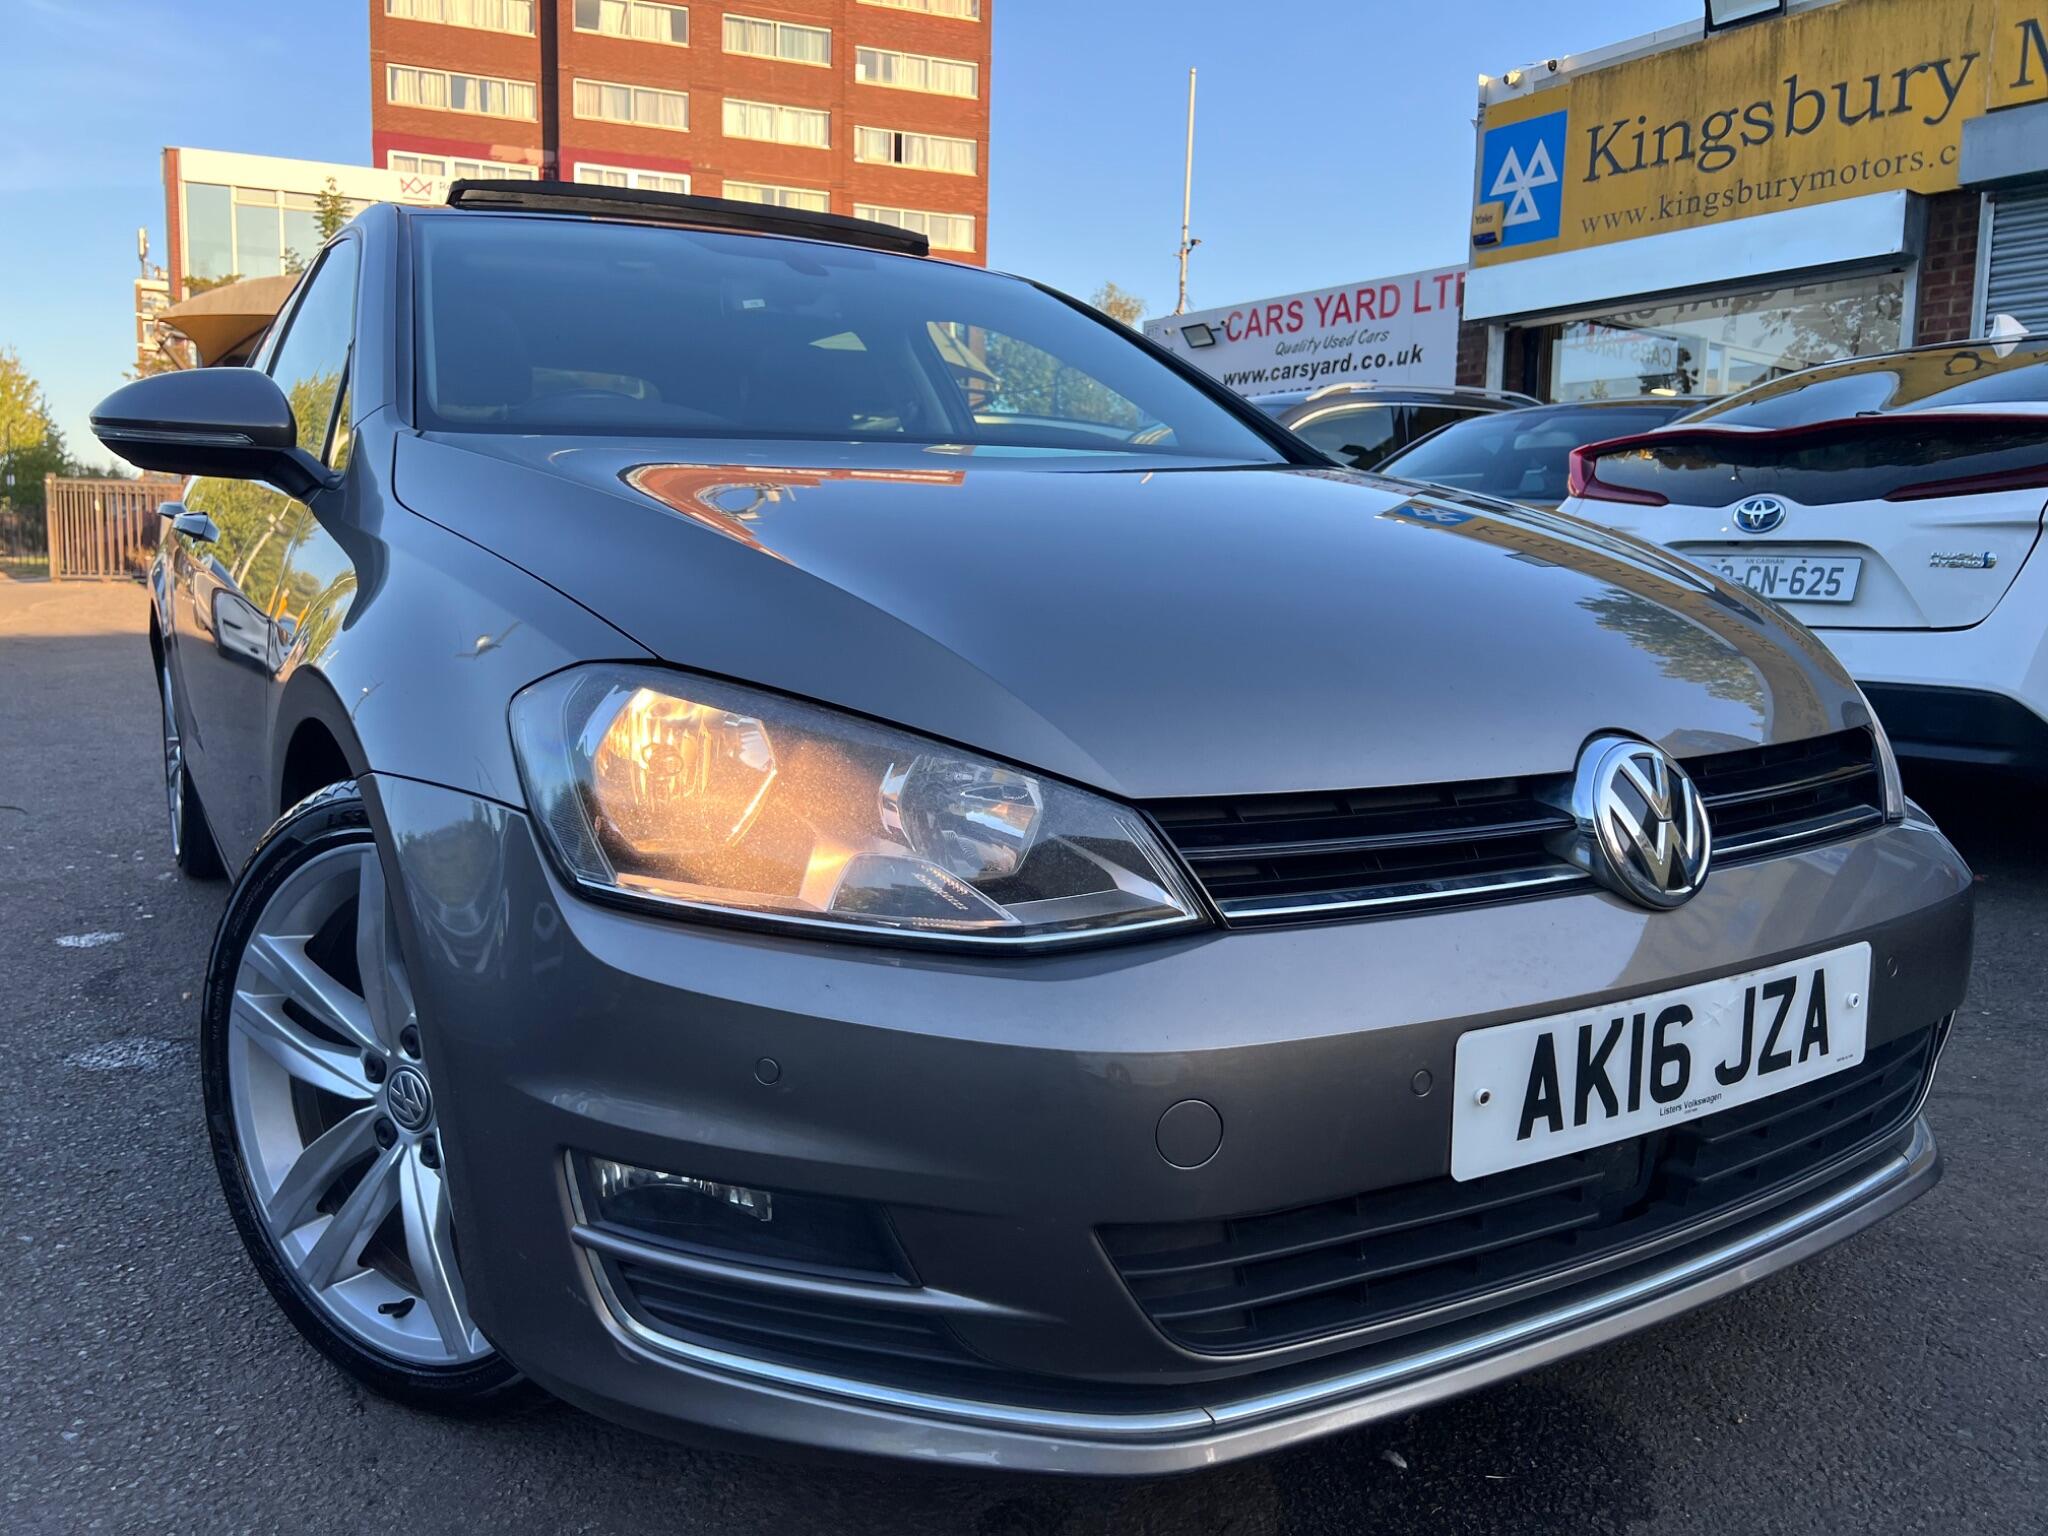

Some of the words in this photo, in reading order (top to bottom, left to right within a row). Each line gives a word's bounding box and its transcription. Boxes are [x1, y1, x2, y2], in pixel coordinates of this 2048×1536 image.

[1582, 52, 1980, 183] Kingsbury
[1226, 300, 1304, 342] CARS
[1314, 284, 1401, 328] YARD
[1223, 344, 1423, 386] www.carsyard.co.uk
[1275, 335, 1322, 356] Quality
[1323, 330, 1356, 349] Used
[1358, 328, 1390, 345] Cars
[1517, 1003, 1694, 1141] AK16
[1715, 968, 1830, 1086] JZA
[1659, 1104, 1682, 1116] Listers
[1683, 1093, 1722, 1109] Volkswagen
